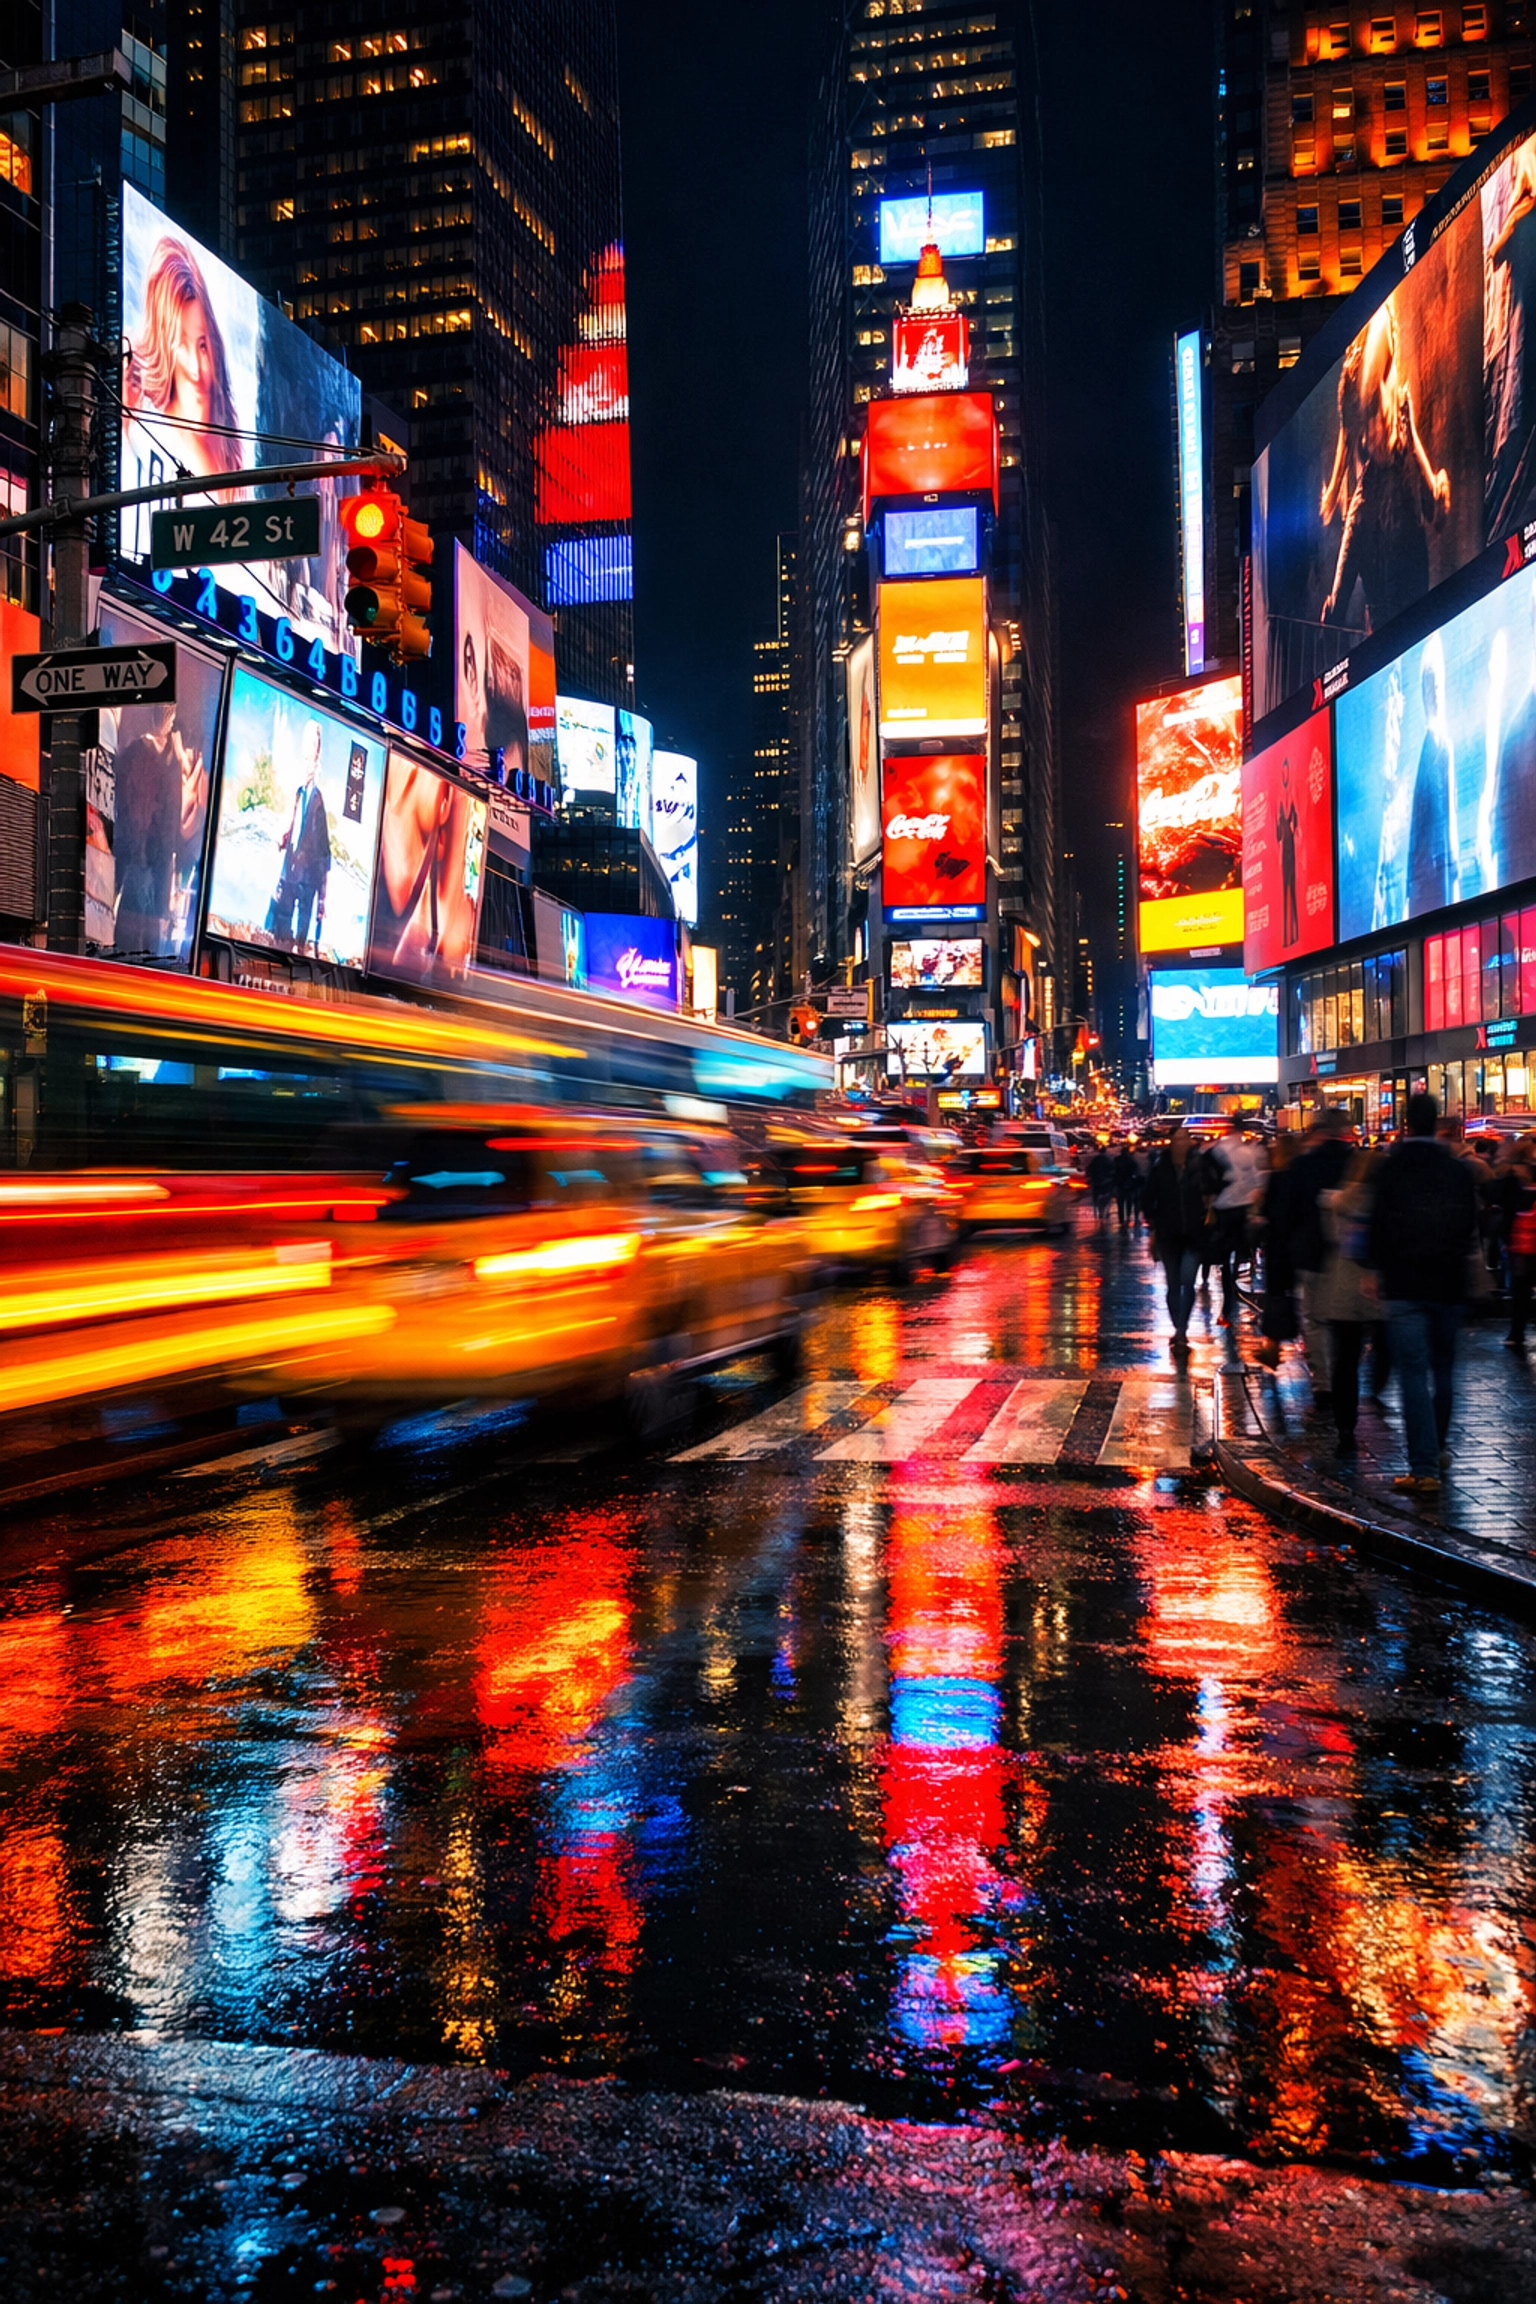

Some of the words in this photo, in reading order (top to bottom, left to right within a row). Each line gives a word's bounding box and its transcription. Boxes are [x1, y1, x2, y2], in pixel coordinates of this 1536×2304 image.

[173, 524, 194, 552] W
[209, 516, 250, 548] 42
[265, 515, 294, 543] St
[35, 667, 85, 694] ONE
[102, 662, 155, 688] WAY
